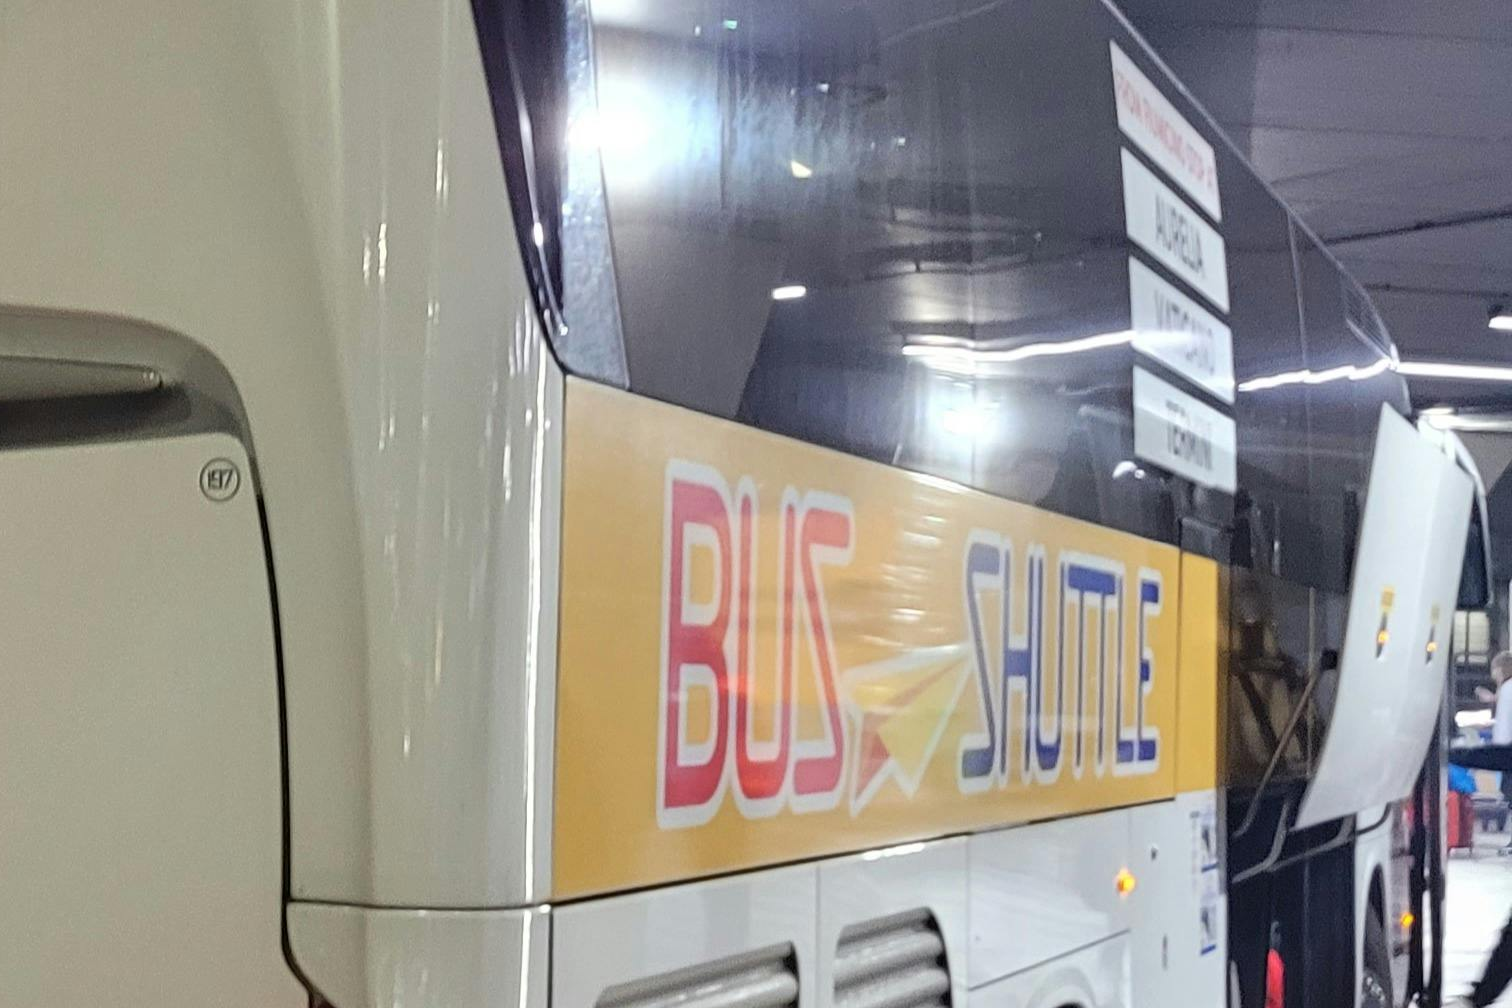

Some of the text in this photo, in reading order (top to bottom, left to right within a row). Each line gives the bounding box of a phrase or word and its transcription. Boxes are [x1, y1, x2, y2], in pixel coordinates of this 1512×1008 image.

[208, 468, 233, 489] 197
[657, 459, 1163, 829] BUS SHUTTLE
